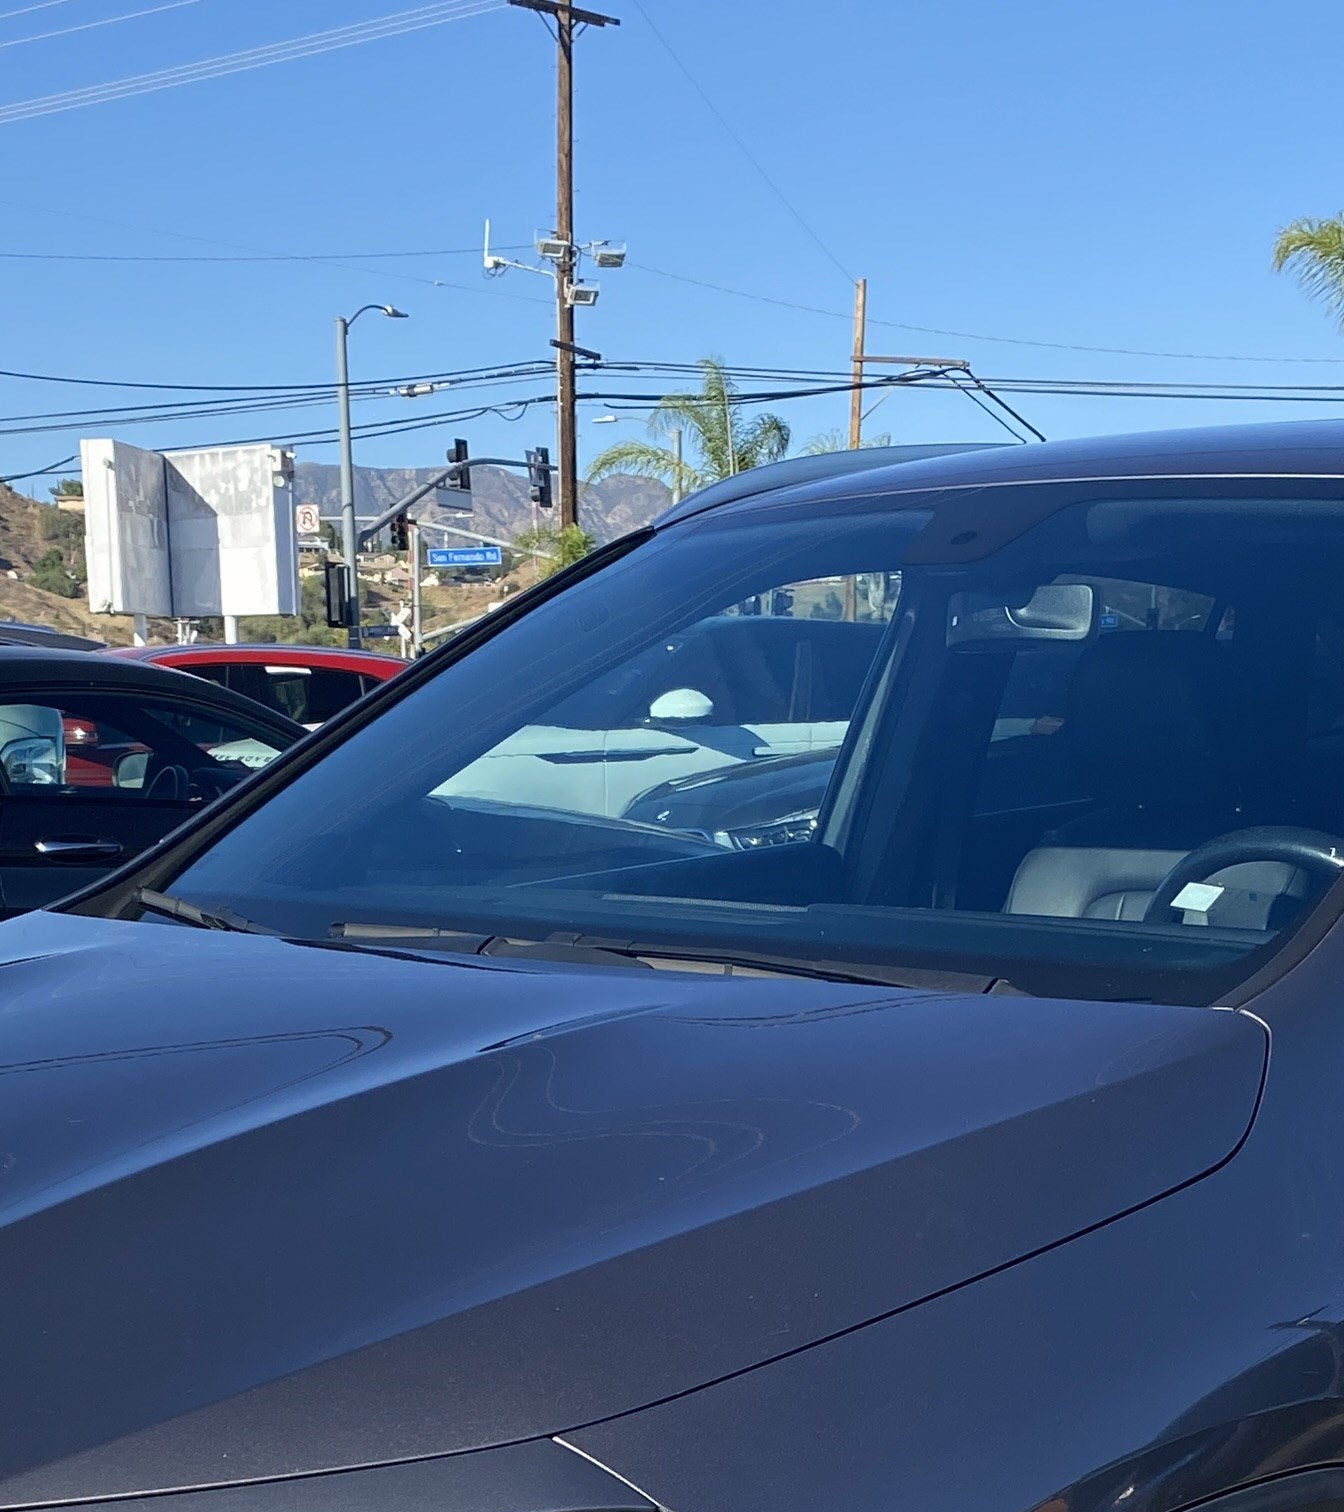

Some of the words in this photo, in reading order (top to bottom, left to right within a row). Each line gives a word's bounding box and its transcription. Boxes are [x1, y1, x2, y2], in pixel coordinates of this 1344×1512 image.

[432, 553, 447, 562] San
[448, 552, 485, 561] Fernando
[485, 551, 497, 560] Rd
